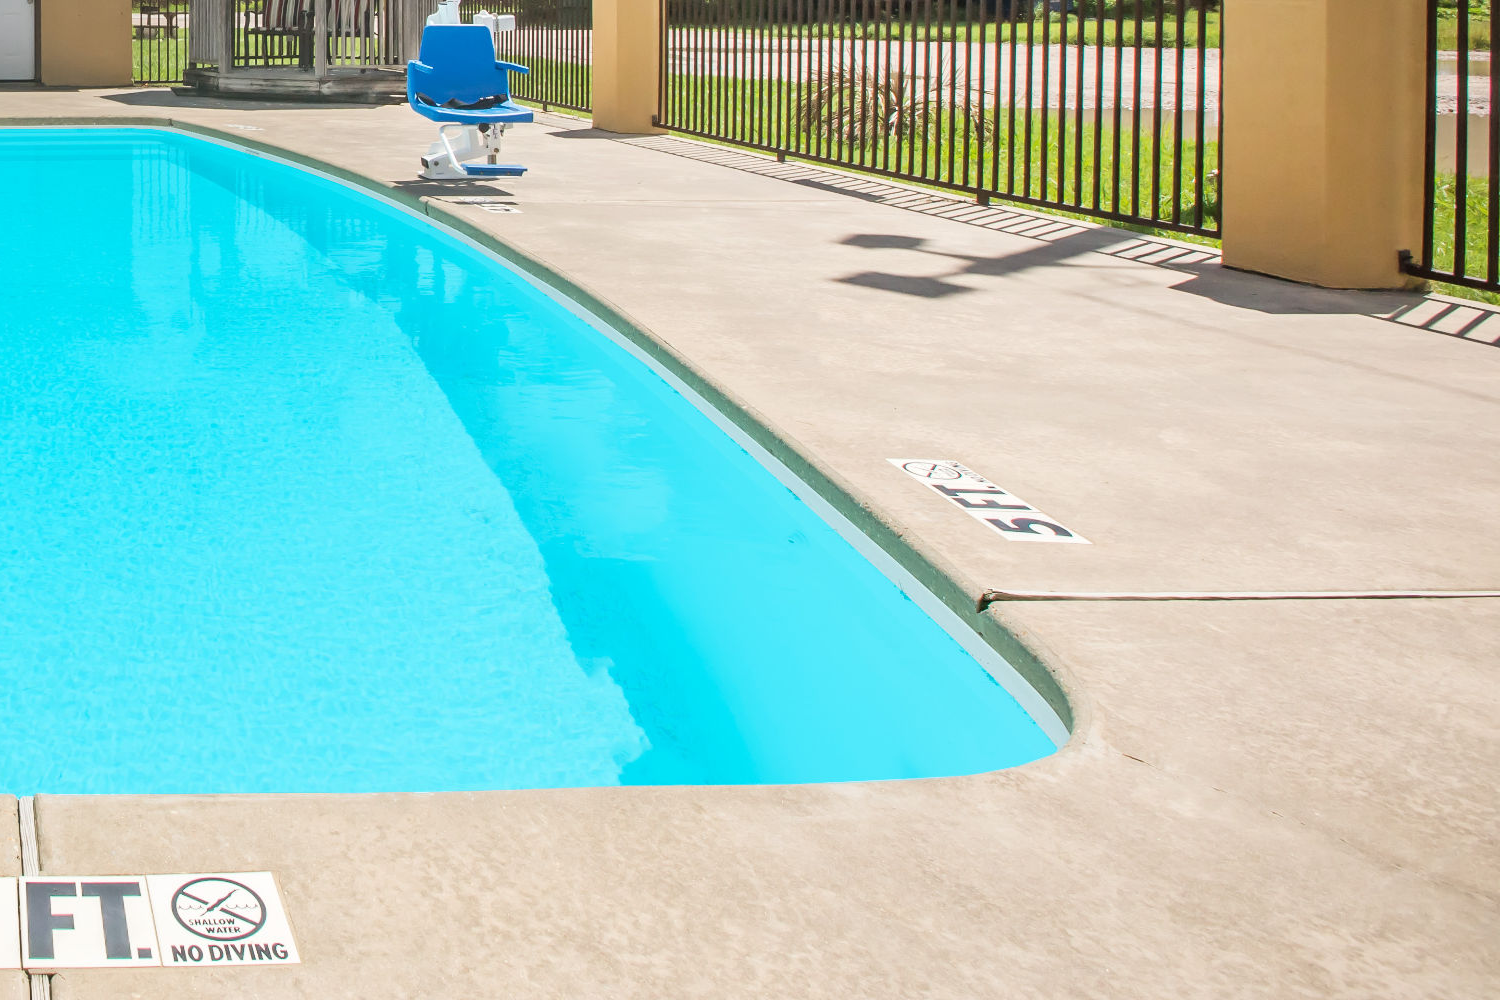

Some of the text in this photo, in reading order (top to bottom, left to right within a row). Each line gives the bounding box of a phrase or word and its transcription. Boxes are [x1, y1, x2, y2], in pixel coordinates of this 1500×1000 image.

[984, 517, 1073, 538] 5
[26, 881, 153, 960] FT.
[188, 918, 235, 926] SHALLOW
[205, 926, 241, 934] WATER
[171, 942, 289, 963] NO DIVING
